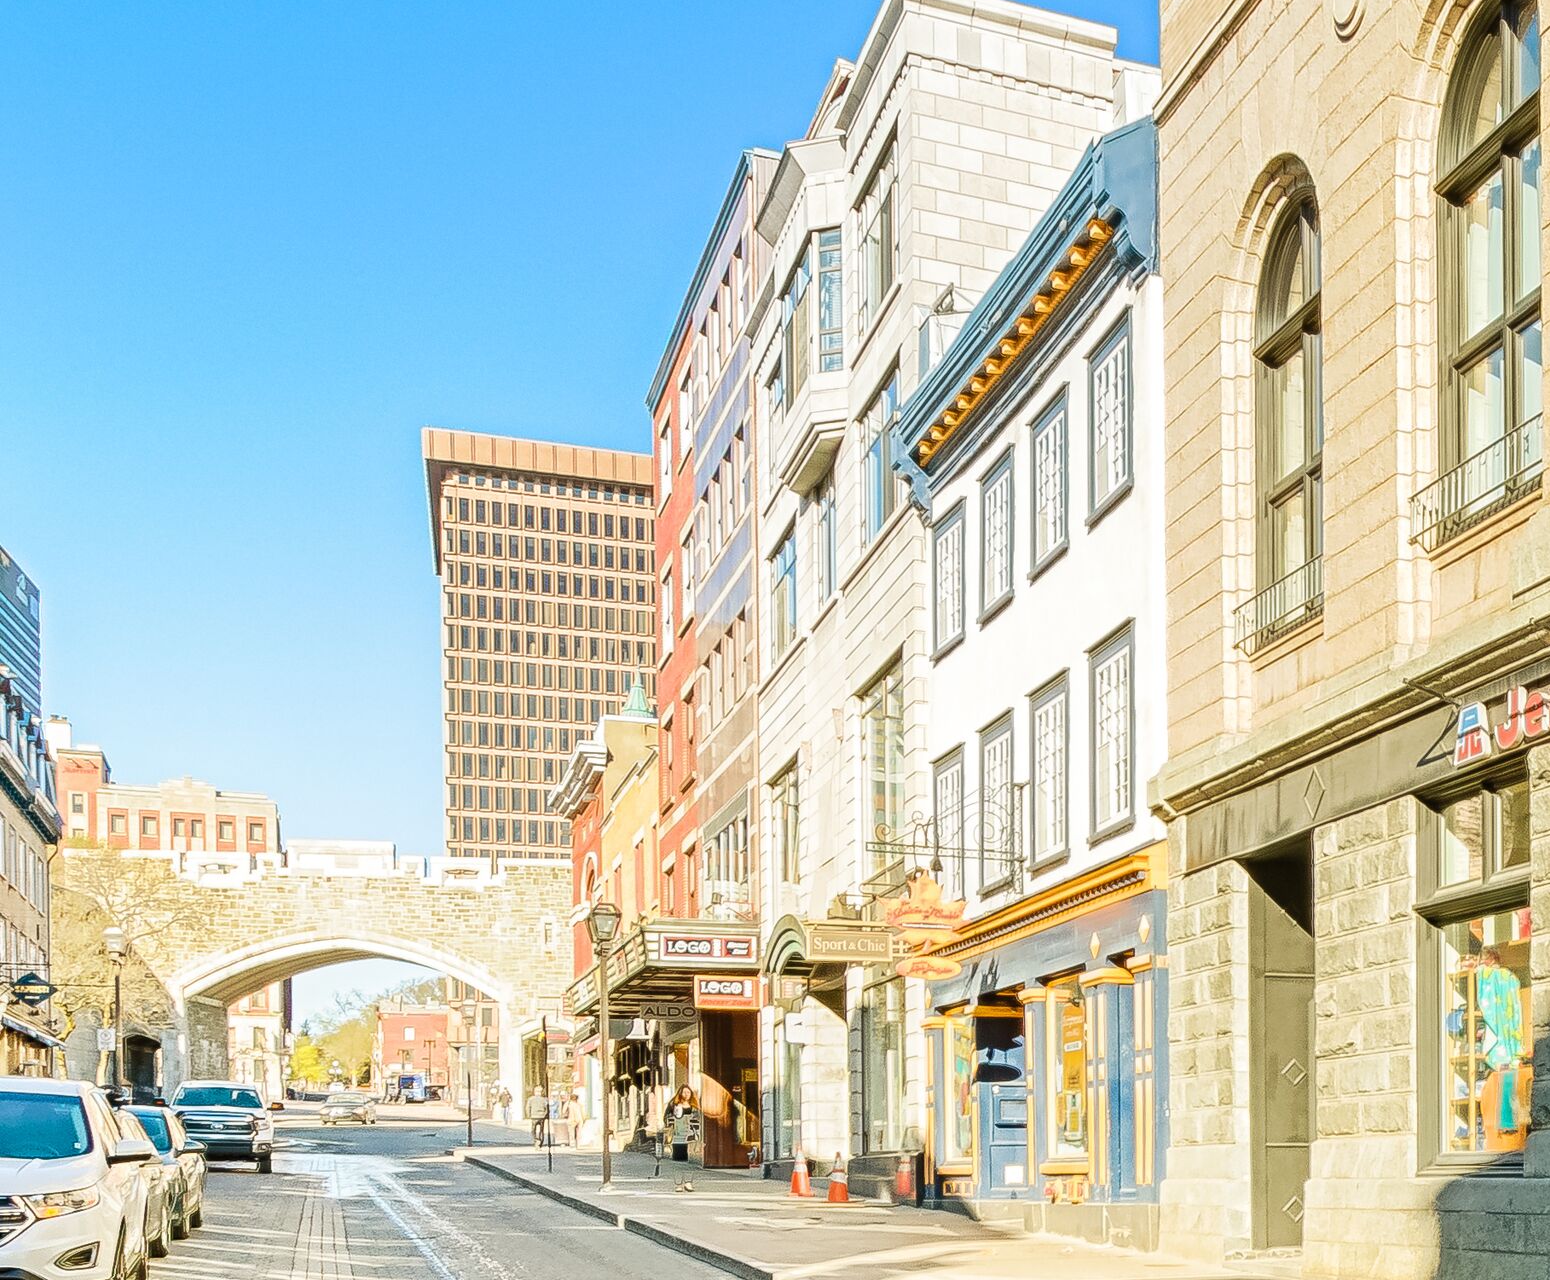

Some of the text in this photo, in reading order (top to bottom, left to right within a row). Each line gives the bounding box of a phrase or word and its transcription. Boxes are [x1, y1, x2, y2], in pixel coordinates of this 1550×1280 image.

[667, 940, 711, 954] LOGO
[813, 938, 848, 952] Sport
[857, 938, 886, 952] Chic
[700, 981, 742, 995] LOGO
[643, 1006, 697, 1017] ALDO
